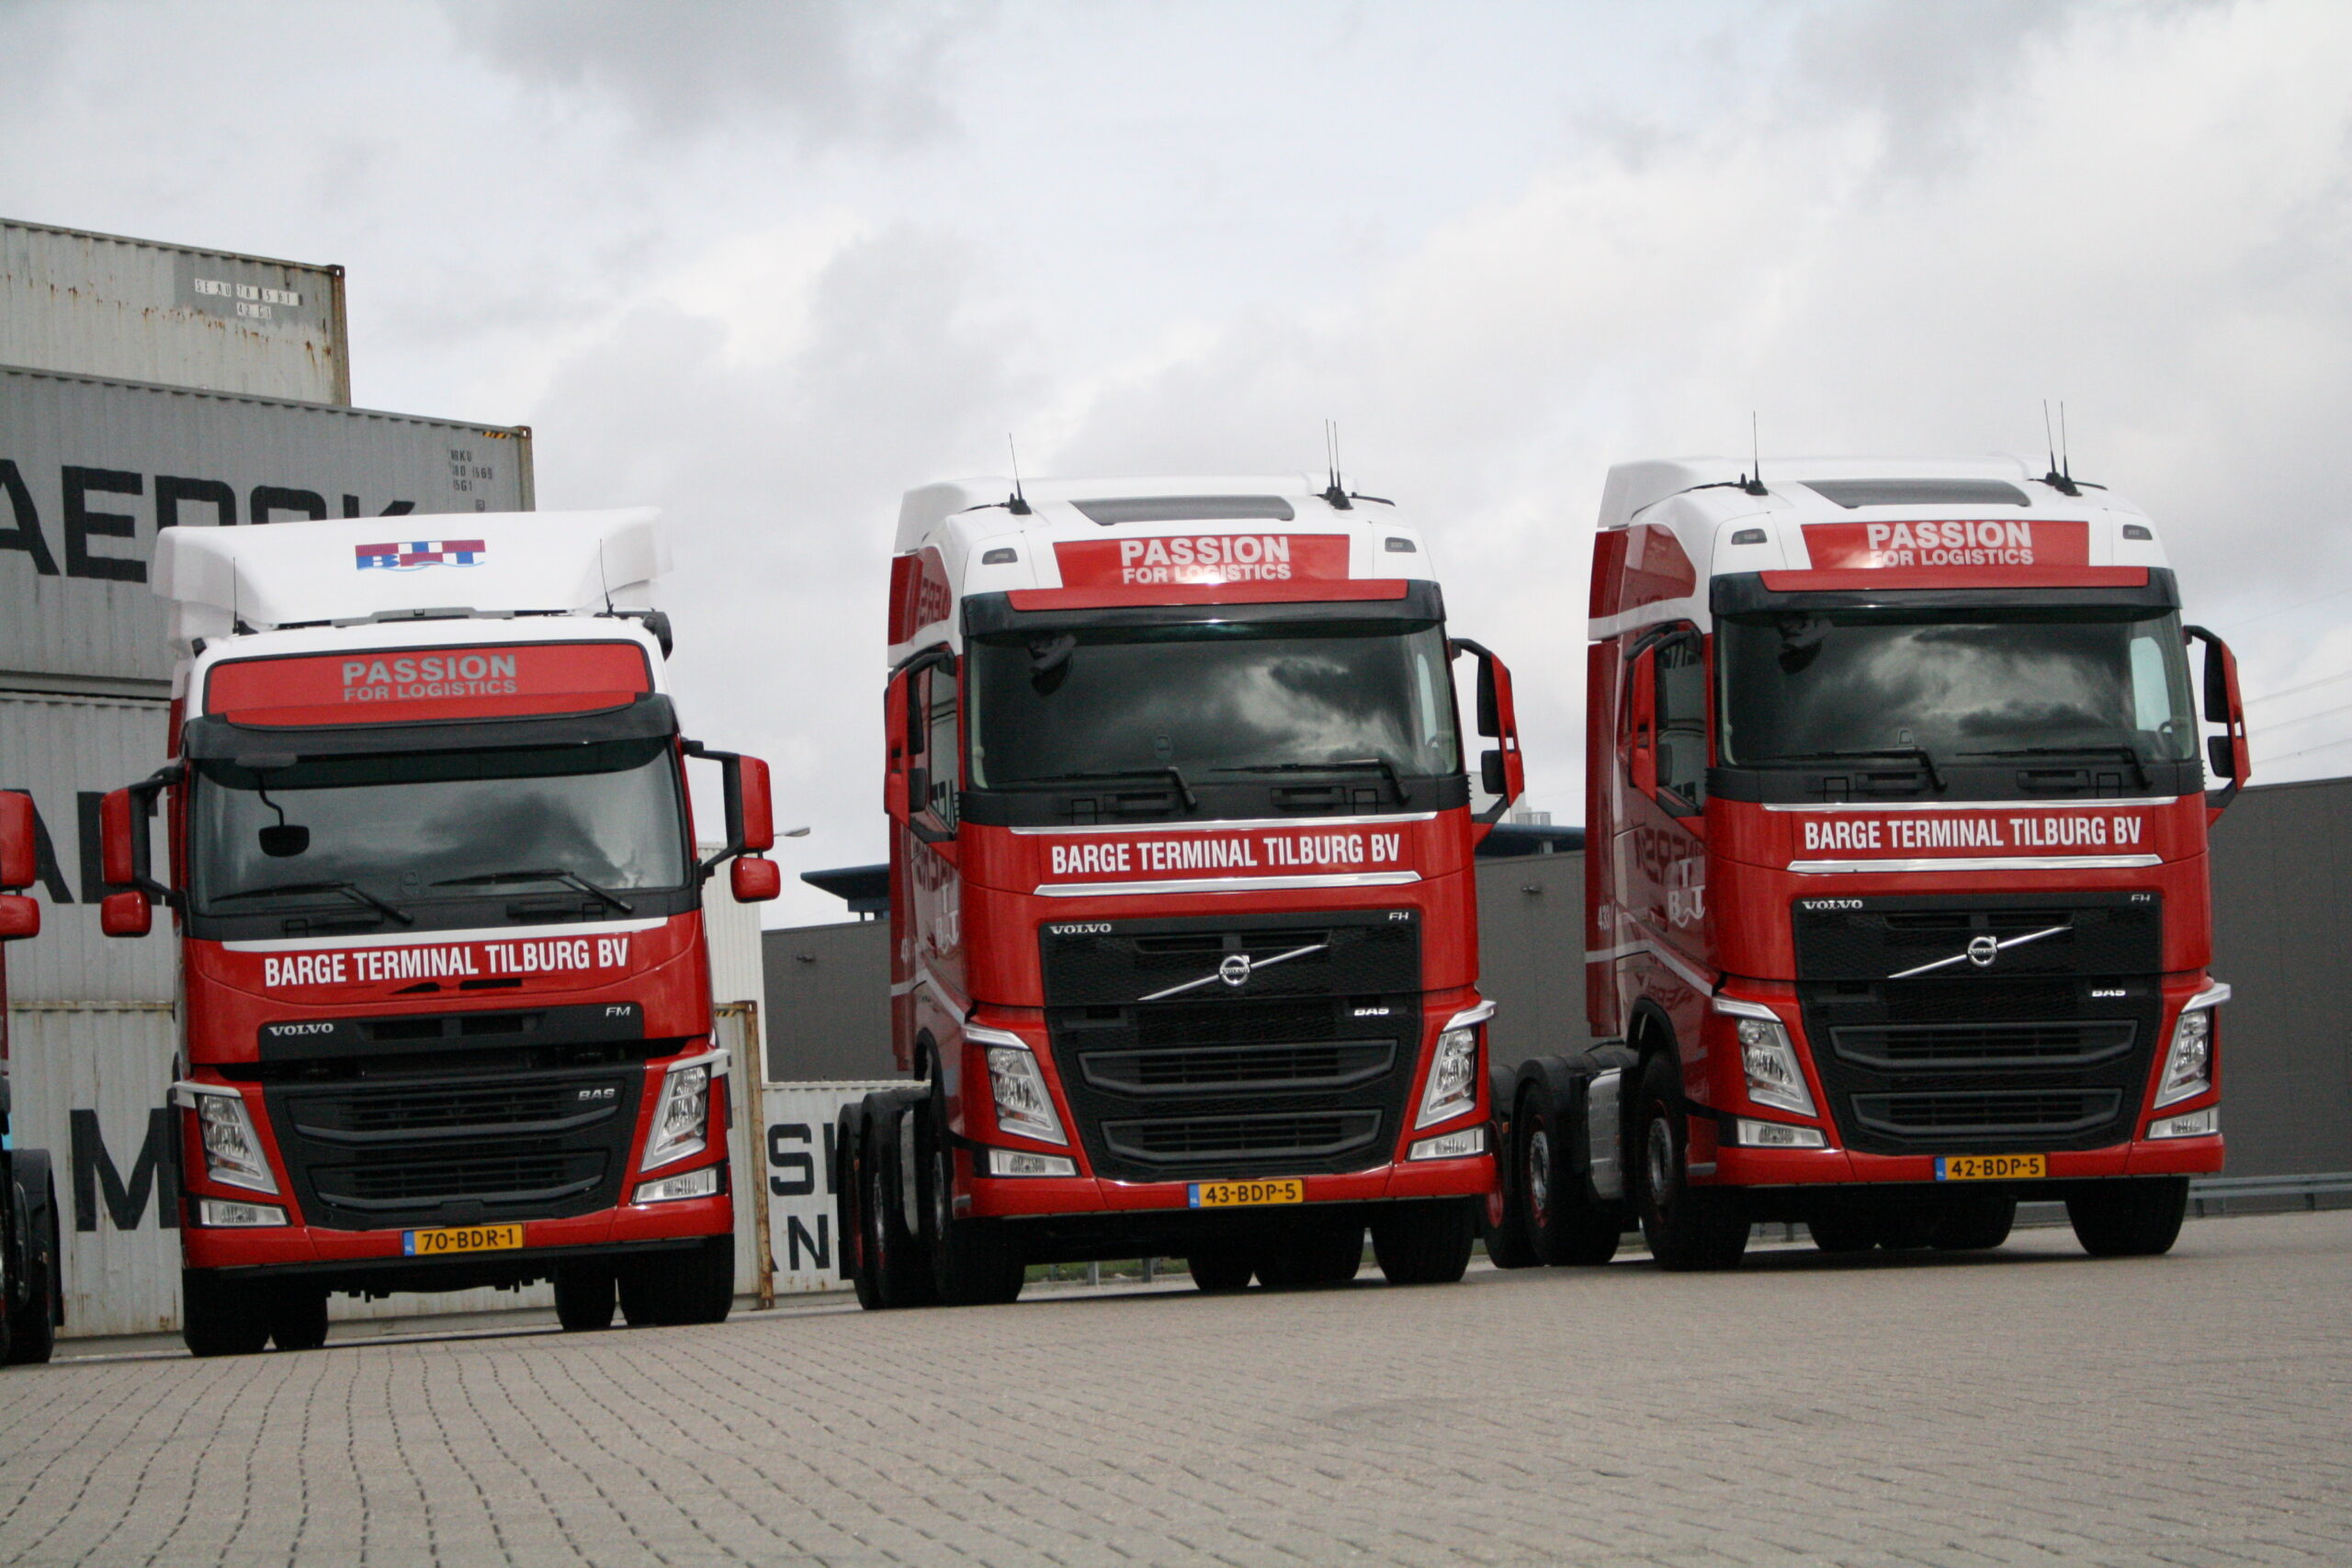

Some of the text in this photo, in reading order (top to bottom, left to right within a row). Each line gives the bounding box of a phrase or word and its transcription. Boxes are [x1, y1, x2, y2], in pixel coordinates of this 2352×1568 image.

[1867, 521, 2032, 549] PASSION
[1120, 536, 1289, 567] PASSION
[1870, 548, 2034, 568] FOR LOGISTICS
[1123, 563, 1292, 584] FOR LOGISTICS
[342, 654, 516, 685] PASSION
[344, 680, 518, 702] FOR LOGISTICS
[1804, 817, 2142, 851] BARGE TERMINAL TILBURG BV
[1052, 833, 1400, 874] BARGE TERMINAL TILBURG BV
[1802, 899, 1863, 910] VOLVO
[2131, 893, 2151, 903] FH
[1388, 911, 1409, 921] FH
[1049, 922, 1112, 934] VOLVO
[265, 938, 628, 987] BARGE TERMINAL TILBURG BV
[605, 1006, 631, 1017] FM
[268, 1022, 334, 1036] VOLVO
[578, 1088, 616, 1100] BAS
[1951, 1157, 2040, 1177] 42-BDP-5
[1205, 1183, 1296, 1203] 43-BDP-5
[422, 1227, 514, 1251] 70-BDR-1
